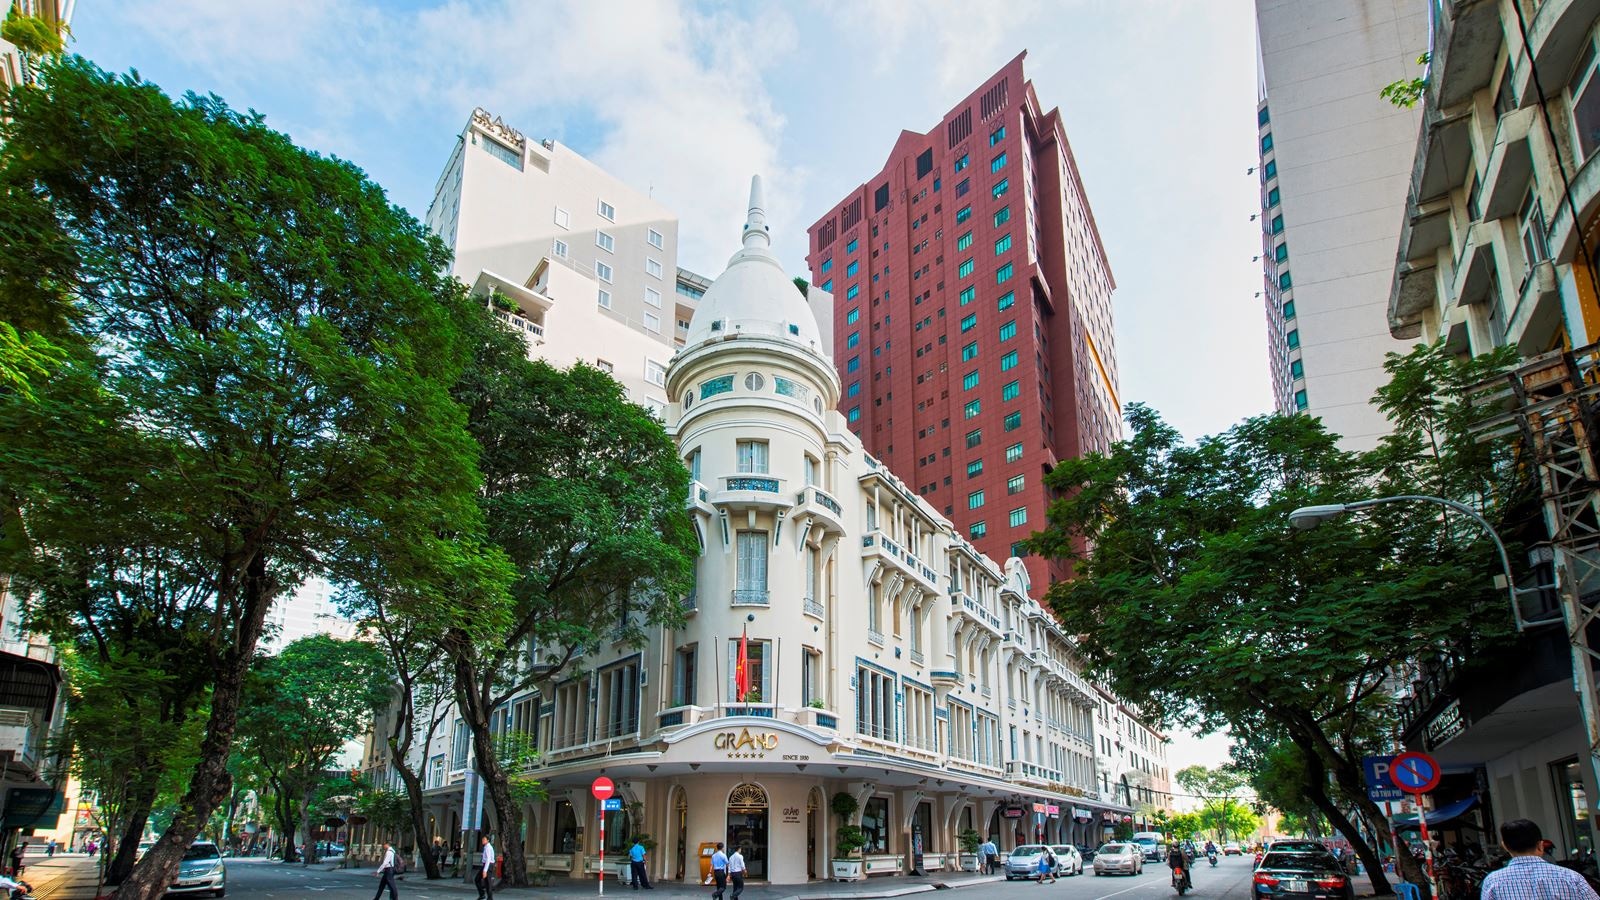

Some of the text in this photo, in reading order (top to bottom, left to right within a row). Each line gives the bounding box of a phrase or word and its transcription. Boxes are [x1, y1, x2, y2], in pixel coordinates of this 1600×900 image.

[474, 107, 524, 143] GRAND
[714, 727, 778, 750] GRAND
[1373, 763, 1389, 779] P
[783, 807, 799, 815] GRAND
